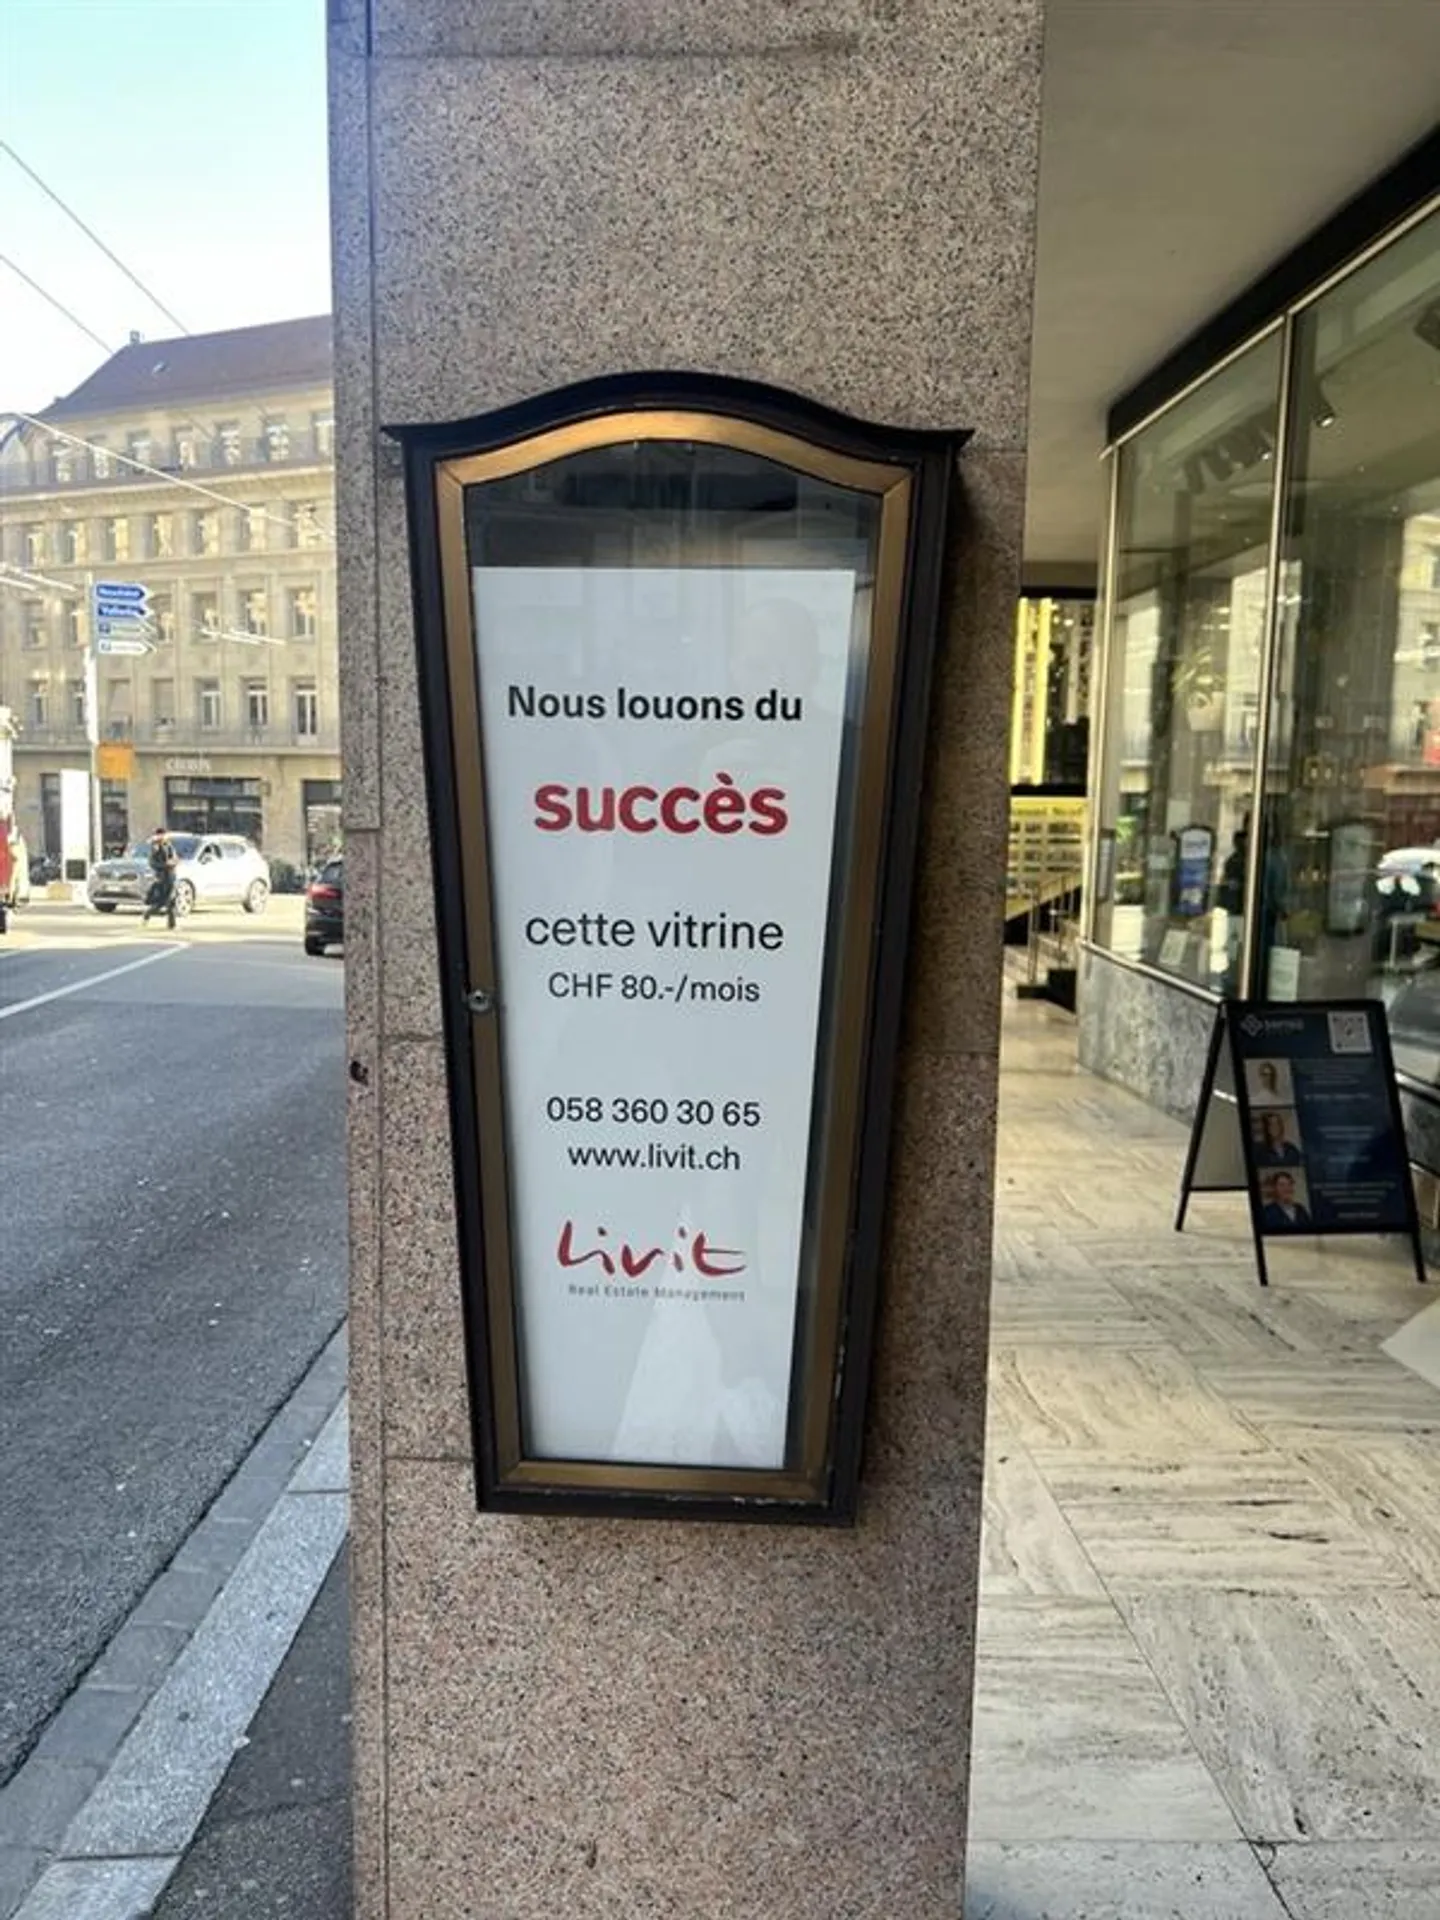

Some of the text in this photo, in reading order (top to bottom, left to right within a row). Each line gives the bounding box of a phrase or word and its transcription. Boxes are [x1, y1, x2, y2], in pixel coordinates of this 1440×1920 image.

[508, 684, 803, 722] Nous louons du
[534, 772, 789, 836] succès
[525, 910, 784, 951] cette vitrine
[548, 971, 761, 1003] CHF 80.-/mois
[546, 1096, 761, 1128] 058 360 30 65
[567, 1142, 741, 1171] www.livit.ch
[568, 1284, 599, 1296] Real
[604, 1285, 649, 1298] Estate
